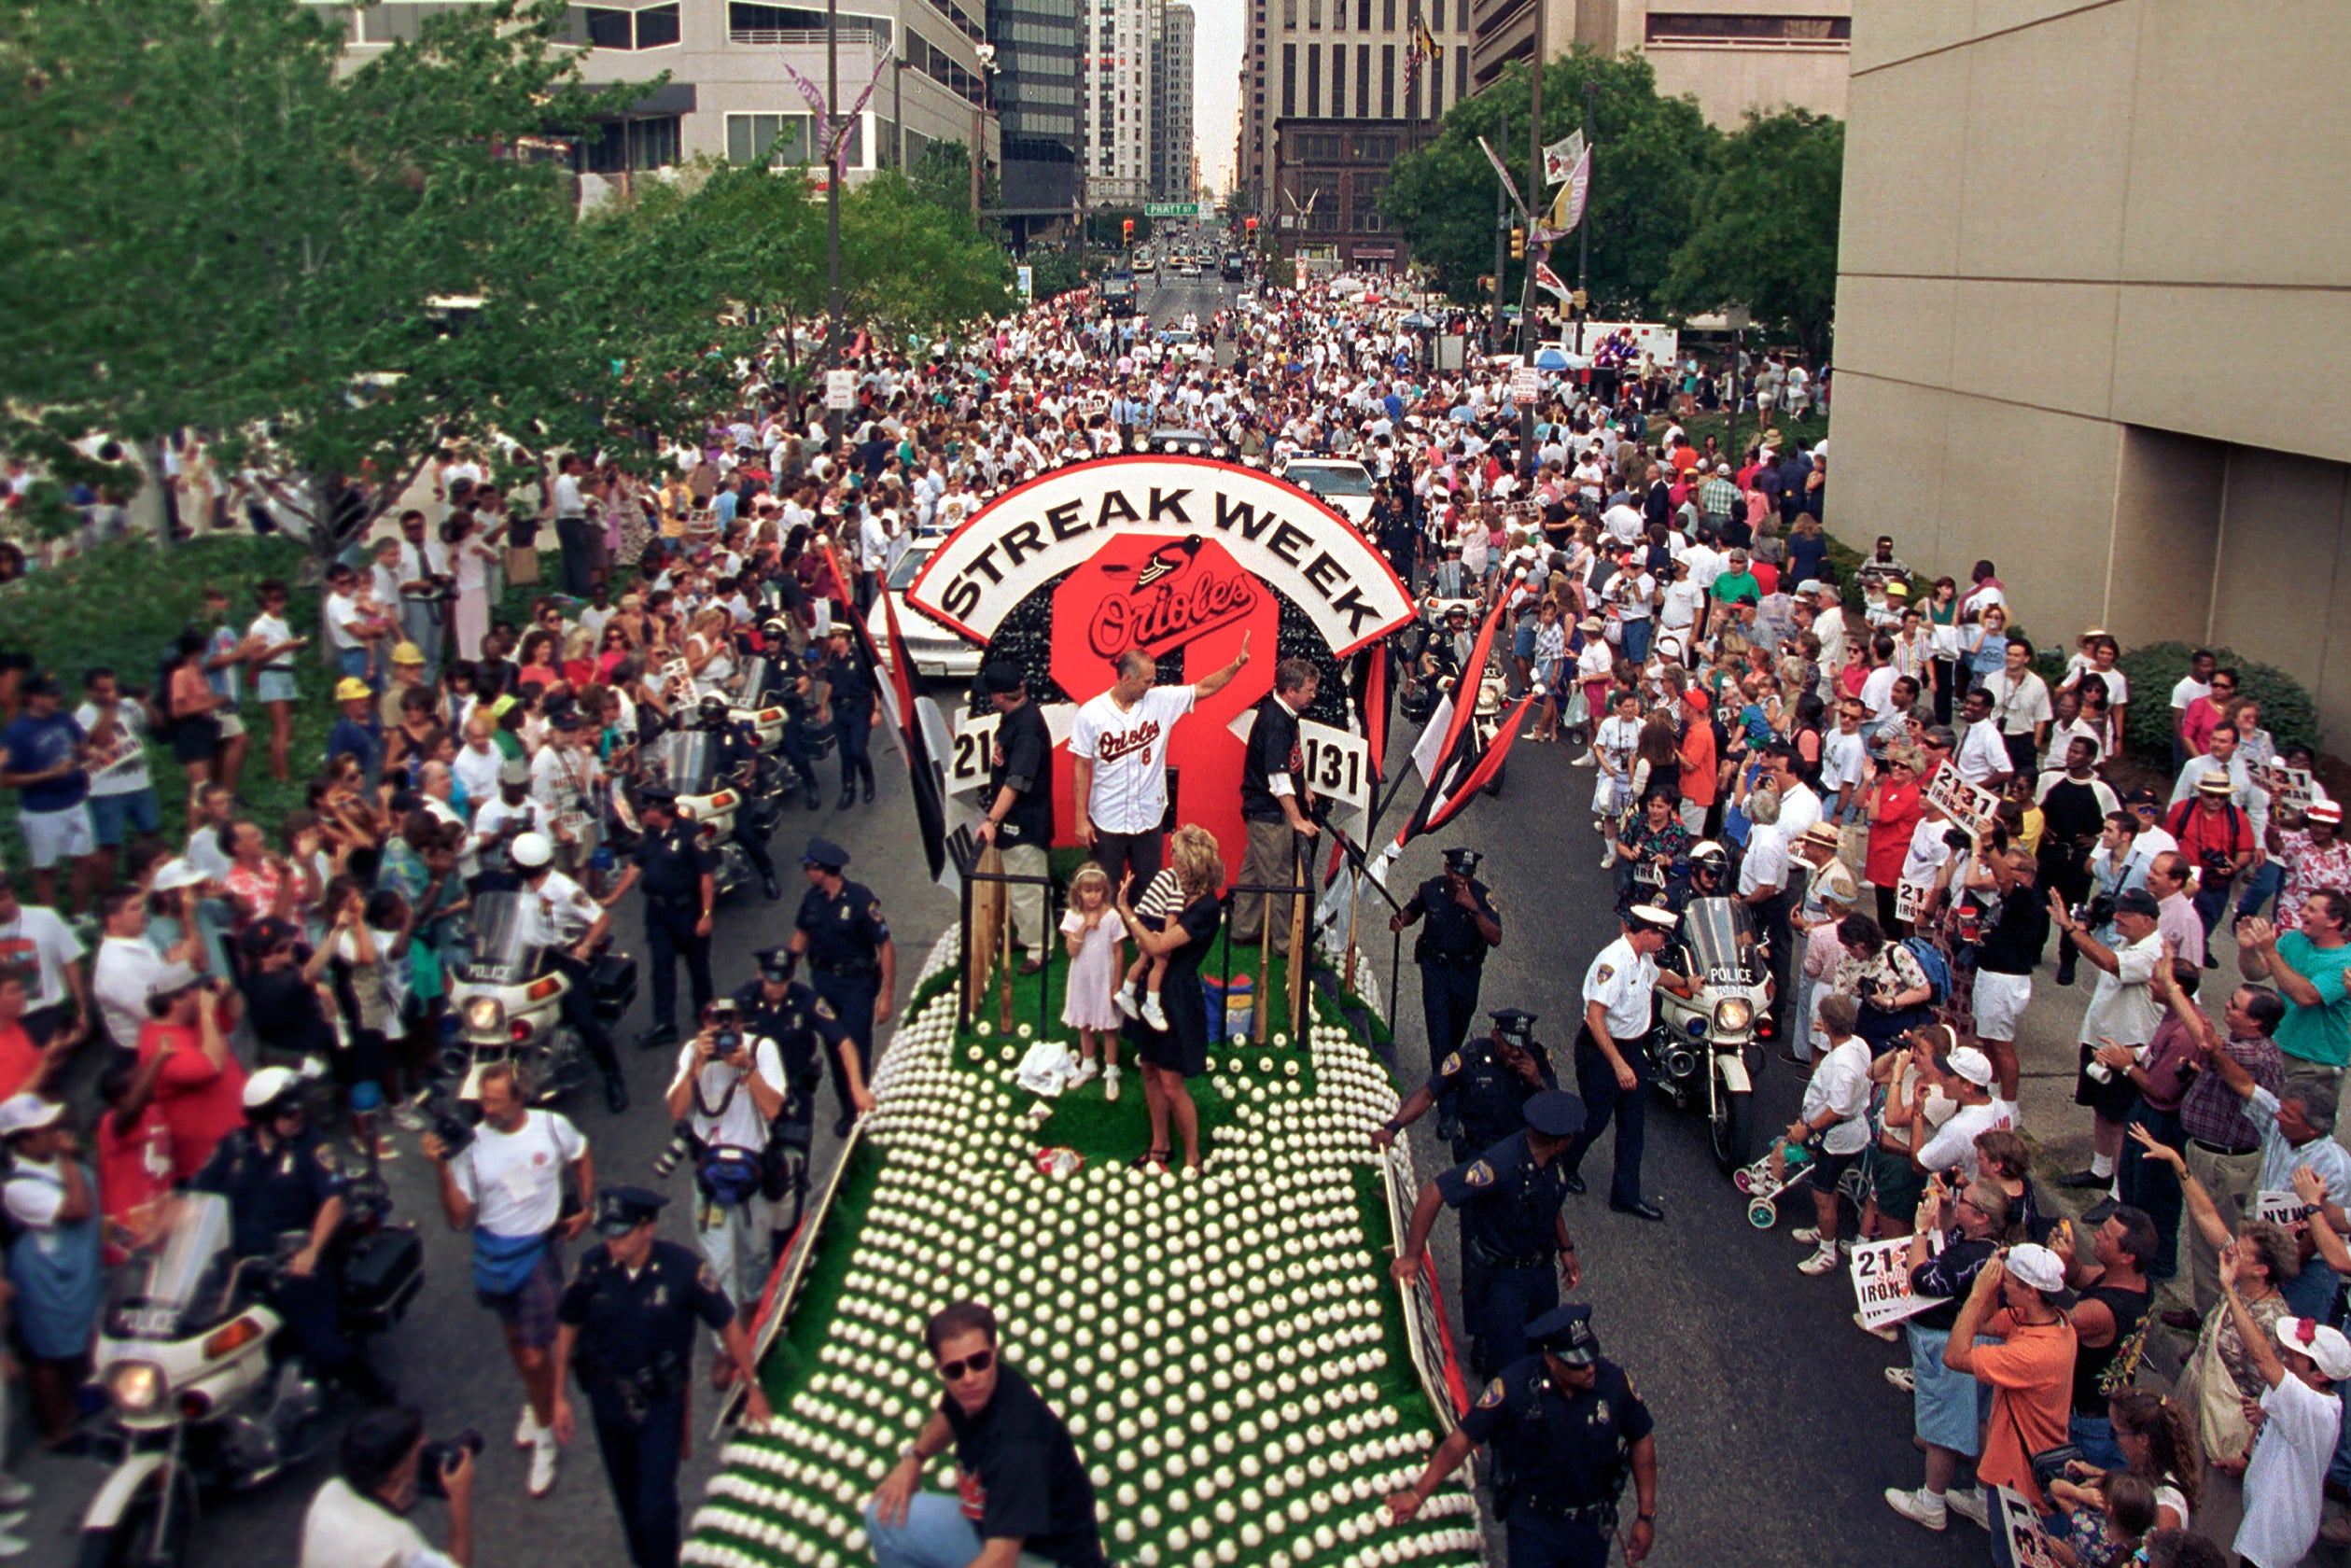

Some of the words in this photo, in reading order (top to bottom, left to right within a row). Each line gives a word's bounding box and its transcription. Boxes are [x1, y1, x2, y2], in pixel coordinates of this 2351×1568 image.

[1151, 204, 1182, 215] PRATT
[941, 487, 1193, 623] STREAK
[1215, 492, 1384, 637] WEEK
[1088, 570, 1257, 661] Orioles
[1099, 720, 1160, 763] Orioles
[1141, 746, 1153, 766] 8
[2245, 758, 2306, 788] 2131
[1931, 786, 1956, 811] IRON
[1938, 767, 1992, 816] 2131
[1899, 883, 1924, 903] 21
[1898, 903, 1916, 917] IRO
[469, 964, 513, 981] POLICE
[1711, 967, 1753, 983] POLICE
[1860, 1281, 1901, 1304] IRON
